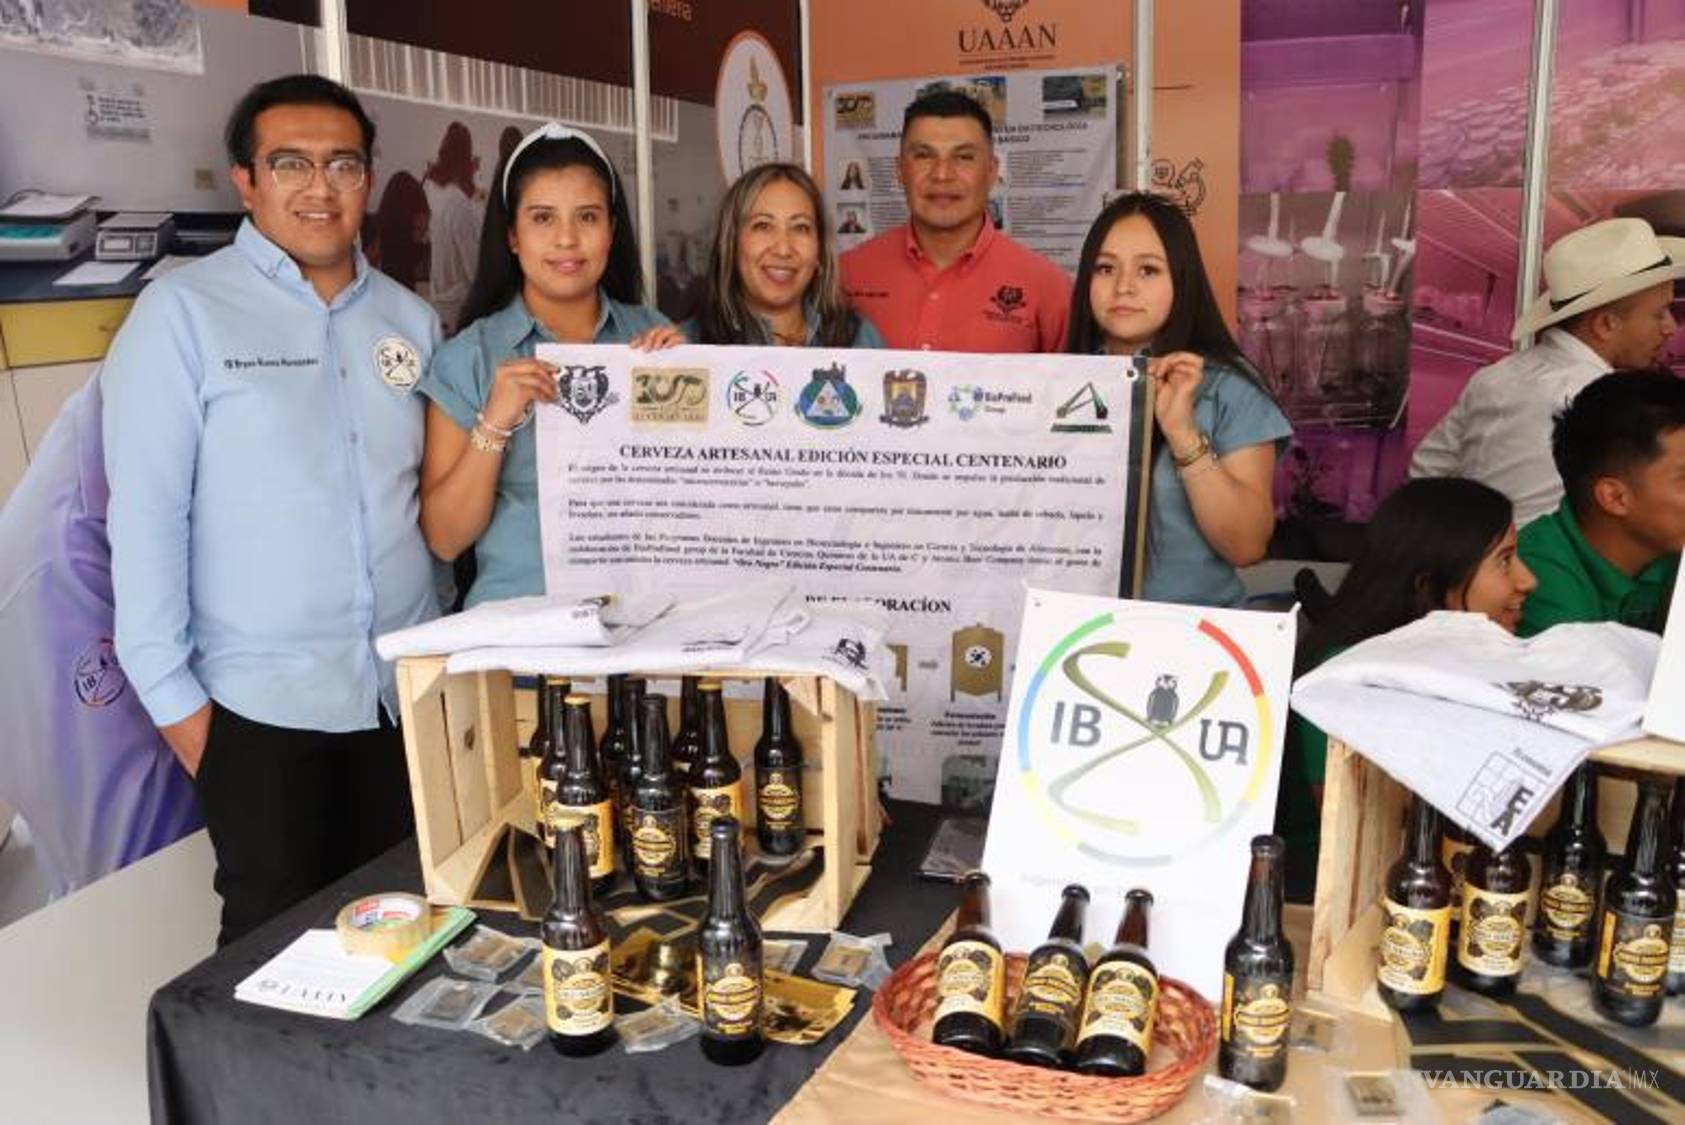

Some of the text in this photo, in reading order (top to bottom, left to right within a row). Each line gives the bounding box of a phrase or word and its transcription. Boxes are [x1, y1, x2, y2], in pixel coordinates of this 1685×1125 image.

[959, 24, 1056, 53] UAAAN
[620, 445, 1067, 469] CERVEZA ARTESANAL EDICIÓN ESPECIAL CENTENARIO
[1050, 700, 1103, 748] IB
[1198, 718, 1249, 766] UA
